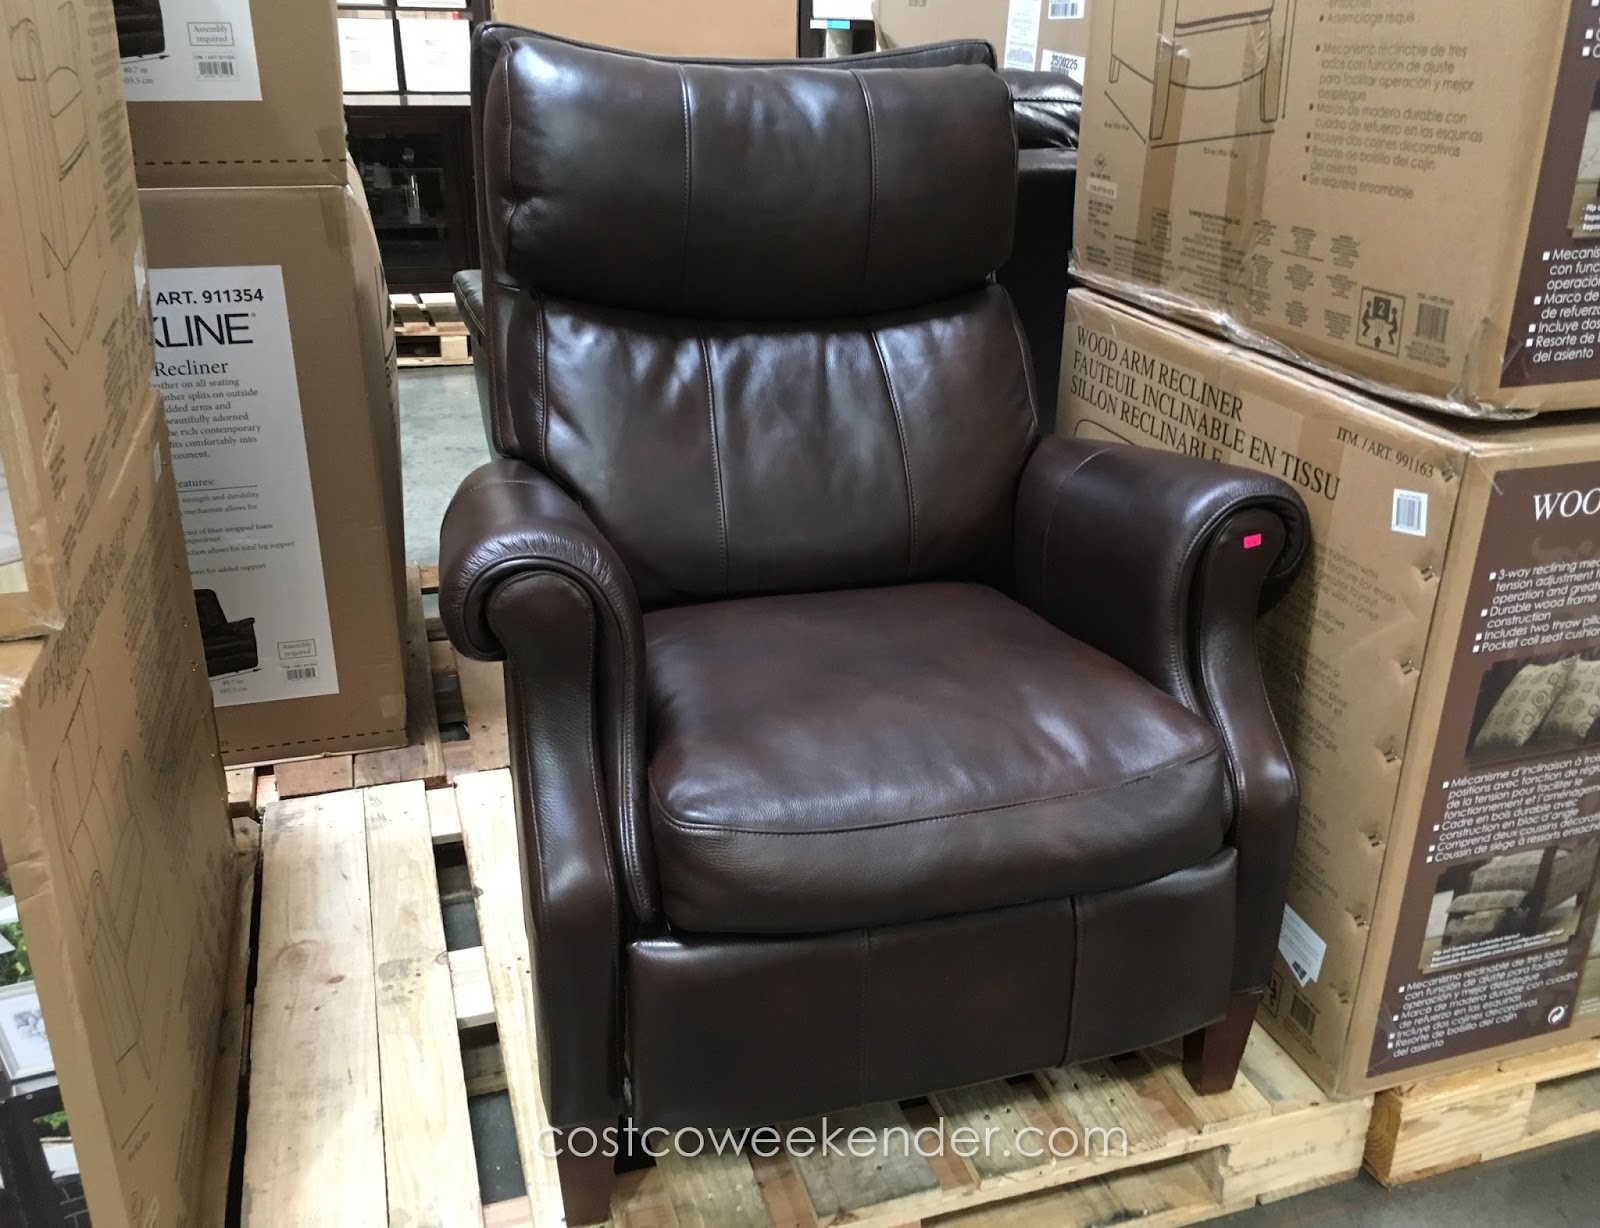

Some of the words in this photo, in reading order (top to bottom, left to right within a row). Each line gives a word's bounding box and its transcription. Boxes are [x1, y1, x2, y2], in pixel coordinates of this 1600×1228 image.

[1327, 12, 1383, 27] Assemblage
[1385, 11, 1415, 25] requis
[193, 25, 228, 34] Assembly
[196, 34, 228, 43] required
[1449, 45, 1467, 58] tres
[1050, 54, 1078, 71] 2500225
[1406, 61, 1421, 73] de
[1423, 61, 1455, 76] ajuste
[1442, 80, 1474, 94] mejor
[1316, 103, 1345, 115] Marco
[1362, 105, 1400, 119] madera
[1403, 107, 1443, 122] durable
[1445, 111, 1467, 125] con
[1314, 118, 1347, 130] cuadro
[1363, 120, 1401, 136] refuerzo
[1419, 125, 1434, 139] las
[1436, 127, 1483, 143] esquinas
[1313, 132, 1344, 147] Incluye
[1346, 133, 1362, 147] dos
[1364, 135, 1398, 151] cojines
[1400, 139, 1461, 158] decorativos
[1325, 161, 1358, 176] asiento
[1393, 153, 1409, 167] del
[1321, 176, 1357, 191] requiere
[1358, 180, 1414, 200] ensamblaje
[1550, 265, 1573, 276] con
[156, 290, 197, 306] ART.
[202, 288, 264, 304] 911354
[1543, 292, 1582, 305] Marco
[1584, 290, 1600, 302] de
[1377, 301, 1386, 316] 2
[1541, 306, 1557, 319] de
[1538, 320, 1579, 336] Incluye
[1581, 317, 1600, 330] dos
[1536, 333, 1577, 348] Resorte
[1580, 331, 1595, 345] de
[1533, 349, 1552, 363] del
[1554, 347, 1594, 362] asiento
[154, 359, 229, 377] Recliner
[1077, 326, 1118, 362] WOOD
[1119, 347, 1157, 379] ARM
[1159, 364, 1243, 422] RECLINER
[195, 378, 206, 388] all
[209, 377, 240, 388] seating
[187, 389, 211, 401] splits
[226, 388, 258, 398] outside
[1070, 374, 1117, 415] SILLON
[214, 401, 231, 411] and
[212, 412, 249, 423] adorned
[1073, 351, 1140, 401] FAUTEUIL
[1142, 384, 1245, 453] INCLINABLE
[1249, 435, 1278, 469] EN
[1281, 451, 1341, 501] TISSU
[180, 426, 199, 436] rich
[200, 424, 261, 436] contemporary
[184, 436, 236, 448] comfortably
[239, 436, 257, 444] into
[1336, 427, 1360, 448] ITM.
[1367, 442, 1392, 462] ART.
[1395, 451, 1434, 479] 991163
[212, 493, 225, 501] and
[226, 491, 259, 501] durability
[207, 547, 229, 555] allows
[269, 541, 295, 551] support
[240, 563, 266, 574] support
[1497, 568, 1531, 582] 3-way
[1532, 560, 1577, 576] reclining
[1495, 577, 1533, 592] tension
[1535, 569, 1594, 588] adjustment
[1492, 588, 1544, 605] operation
[1546, 585, 1568, 598] and
[1489, 602, 1532, 617] Durable
[1534, 595, 1565, 610] wood
[1566, 593, 1598, 607] frame
[1483, 626, 1528, 641] Includes
[1529, 620, 1550, 634] two
[1552, 616, 1582, 631] throw
[1486, 610, 1551, 629] construction
[1481, 638, 1519, 653] Pocket
[1520, 633, 1540, 647] coil
[1541, 630, 1563, 645] seat
[1448, 784, 1491, 801] positions
[1493, 779, 1520, 791] avec
[1521, 770, 1562, 786] fonction
[1564, 767, 1578, 779] de
[1451, 770, 1510, 788] Mécanisme
[1446, 798, 1460, 810] de
[1474, 789, 1510, 806] tension
[1511, 785, 1535, 800] pour
[1536, 779, 1573, 793] faciliter
[1441, 816, 1474, 832] Cadre
[1491, 808, 1511, 822] bois
[1512, 801, 1552, 818] durable
[1553, 798, 1578, 810] avec
[1444, 796, 1523, 820] fonctionnement
[1439, 823, 1500, 842] construction
[1517, 814, 1540, 827] bloc
[1541, 808, 1580, 824] d'angle
[1434, 846, 1472, 863] Coussin
[1473, 843, 1488, 856] de
[1489, 838, 1516, 853] siège
[1526, 829, 1561, 845] ressorts
[1436, 833, 1491, 853] Comprend
[1492, 828, 1518, 842] deux
[1519, 820, 1558, 837] coussins
[1404, 990, 1424, 1001] con
[1425, 979, 1461, 998] función
[1463, 976, 1477, 988] de
[1477, 970, 1506, 986] ajuste
[1507, 967, 1531, 981] para
[1531, 957, 1566, 973] facilitar
[1406, 971, 1463, 992] Mecanismo
[1463, 962, 1510, 979] reclinable
[1511, 957, 1525, 969] de
[1526, 953, 1543, 966] tres
[1544, 947, 1569, 961] lados
[1400, 1006, 1433, 1021] Marco
[1434, 1002, 1448, 1013] de
[1449, 993, 1488, 1009] madera
[1488, 984, 1525, 1001] durable
[1525, 979, 1545, 992] con
[1545, 971, 1579, 987] cuadro
[1402, 992, 1453, 1012] operación
[1461, 983, 1489, 999] mejor
[1489, 971, 1540, 992] despliegue
[1396, 1023, 1431, 1040] Incluye
[1432, 1018, 1450, 1031] dos
[1451, 1011, 1483, 1029] cojines
[1484, 999, 1539, 1018] decorativos
[1399, 1018, 1413, 1030] de
[1413, 1010, 1452, 1027] refuerzo
[1482, 994, 1522, 1012] esquinas
[1395, 1033, 1430, 1050] Resorte
[1431, 1028, 1445, 1040] de
[1446, 1020, 1478, 1037] bolsillo
[1478, 1016, 1495, 1029] del
[1393, 1045, 1410, 1059] del
[1410, 1038, 1445, 1055] asiento
